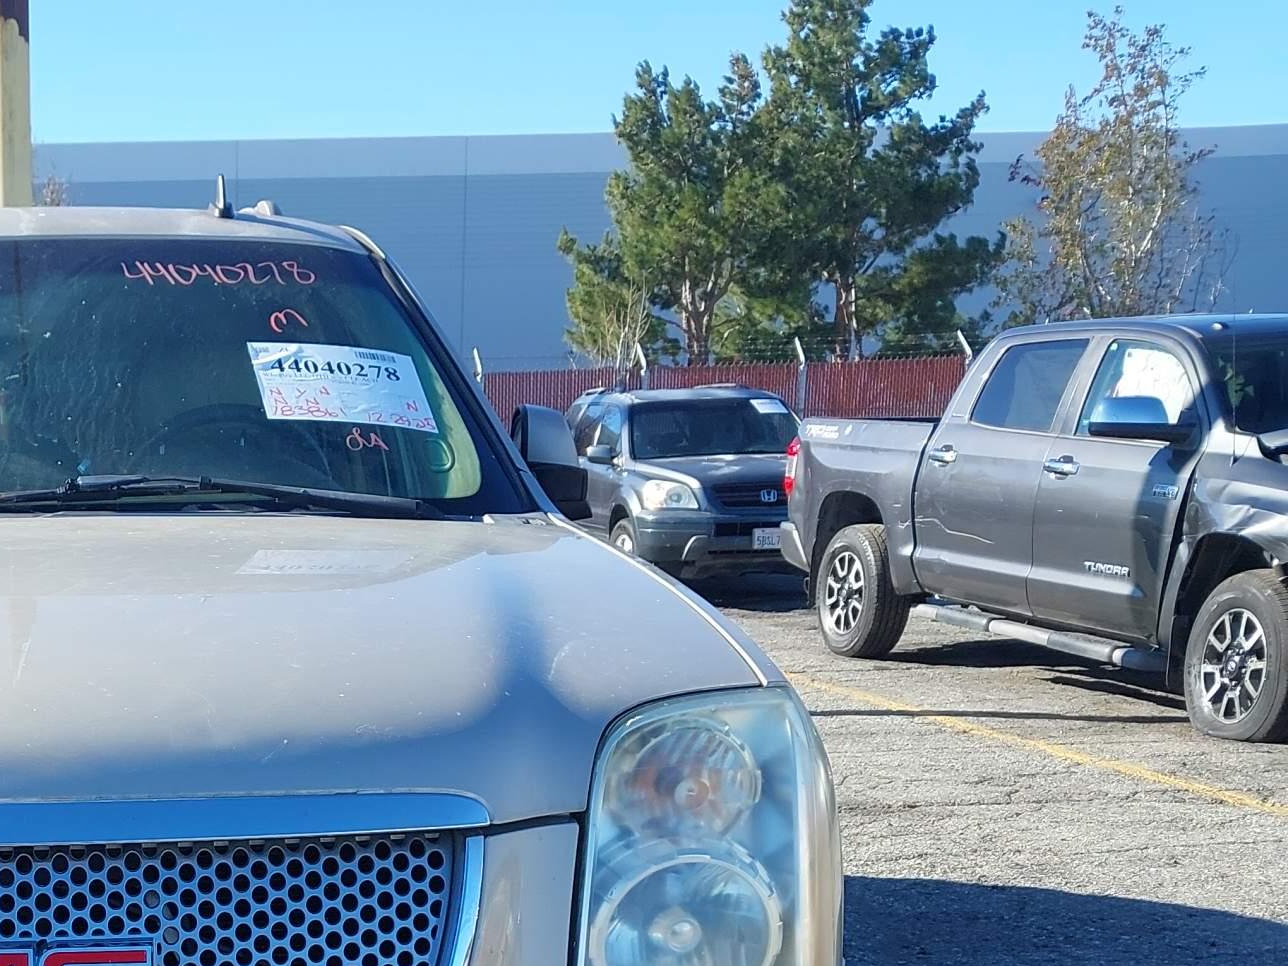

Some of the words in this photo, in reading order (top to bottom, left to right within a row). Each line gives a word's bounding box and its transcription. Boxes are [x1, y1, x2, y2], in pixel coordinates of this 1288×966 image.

[120, 261, 315, 286] 44040278
[271, 358, 401, 382] 44040278
[1084, 561, 1130, 577] TUNDRA
